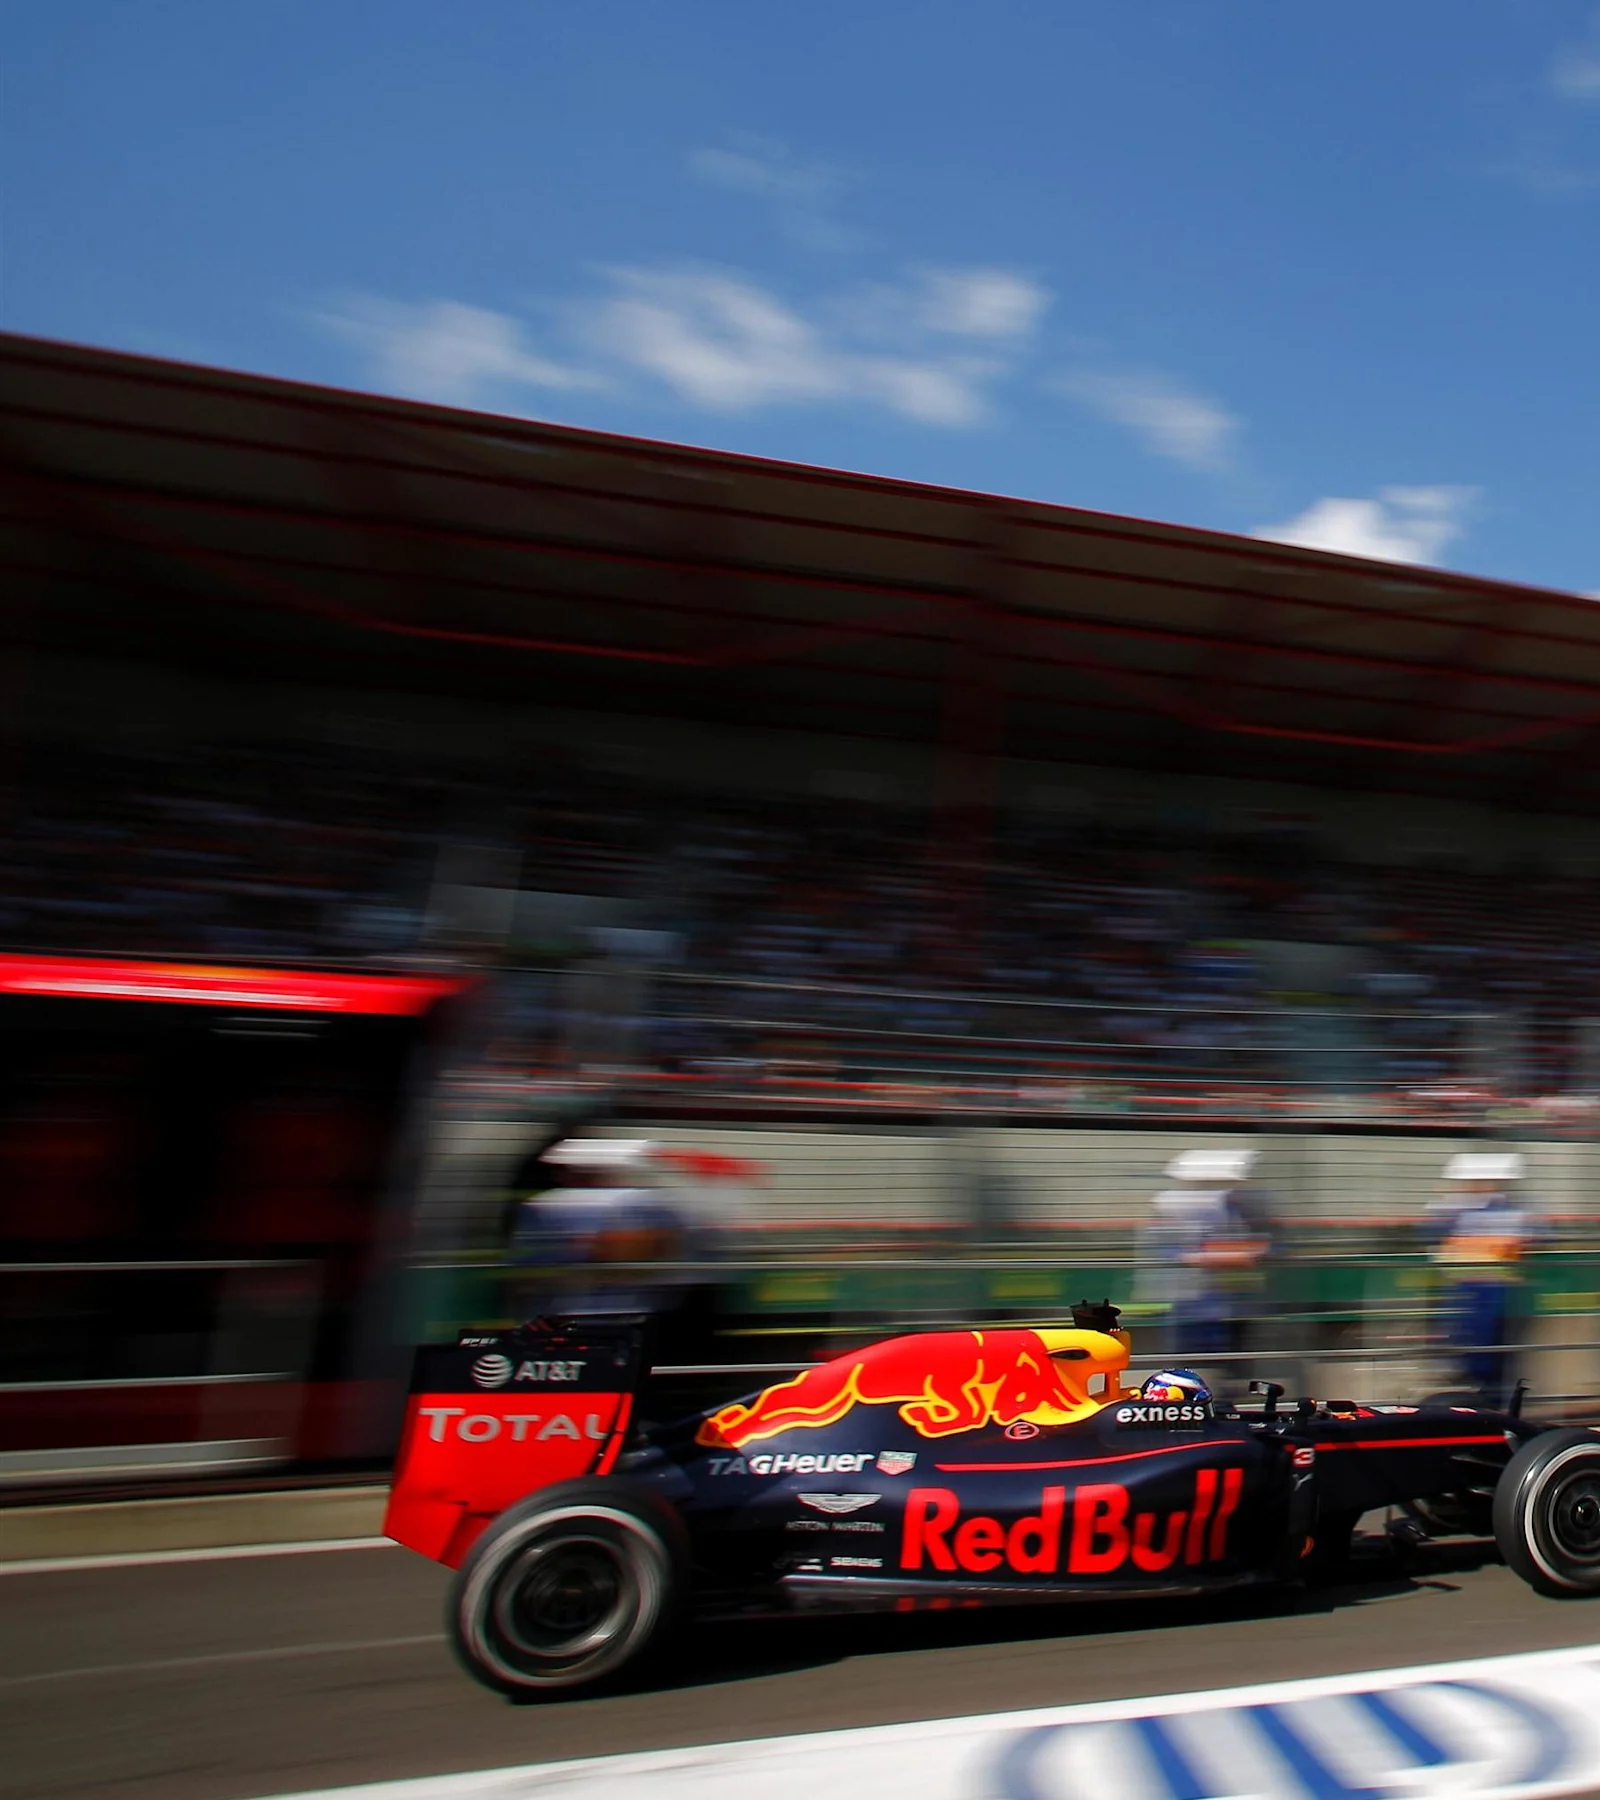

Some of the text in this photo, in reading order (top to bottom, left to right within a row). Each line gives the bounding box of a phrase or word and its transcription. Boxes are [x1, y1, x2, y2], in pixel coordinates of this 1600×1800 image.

[514, 1361, 587, 1382] AT&T
[1116, 1404, 1205, 1424] exness
[418, 1407, 609, 1444] TOTAL
[1293, 1448, 1316, 1467] 3
